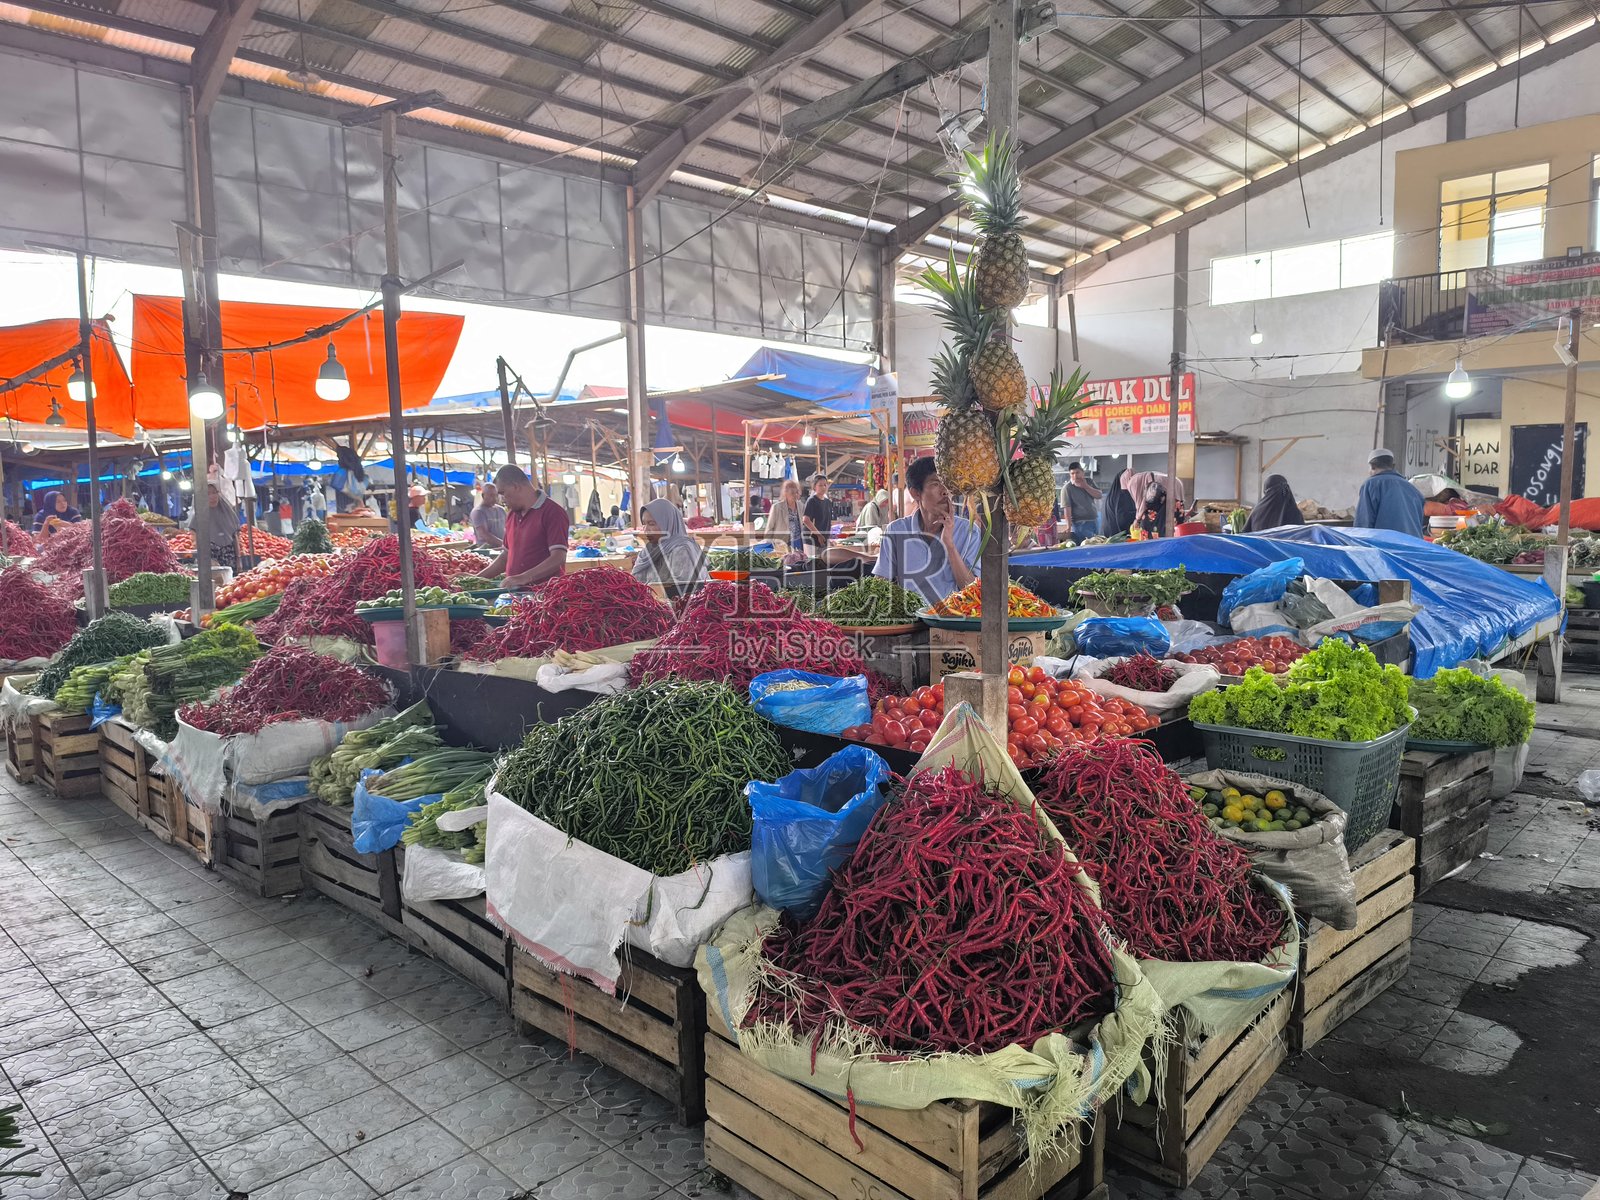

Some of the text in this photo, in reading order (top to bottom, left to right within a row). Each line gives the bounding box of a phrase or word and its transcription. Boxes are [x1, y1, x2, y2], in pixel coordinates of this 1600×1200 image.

[1087, 378, 1138, 405] WAK
[1143, 375, 1190, 401] DUL
[1082, 401, 1192, 418] NASI GORENG DAN OPI
[1407, 424, 1440, 468] OILET
[942, 652, 976, 670] Sajiku
[1009, 642, 1033, 664] Sajiku
